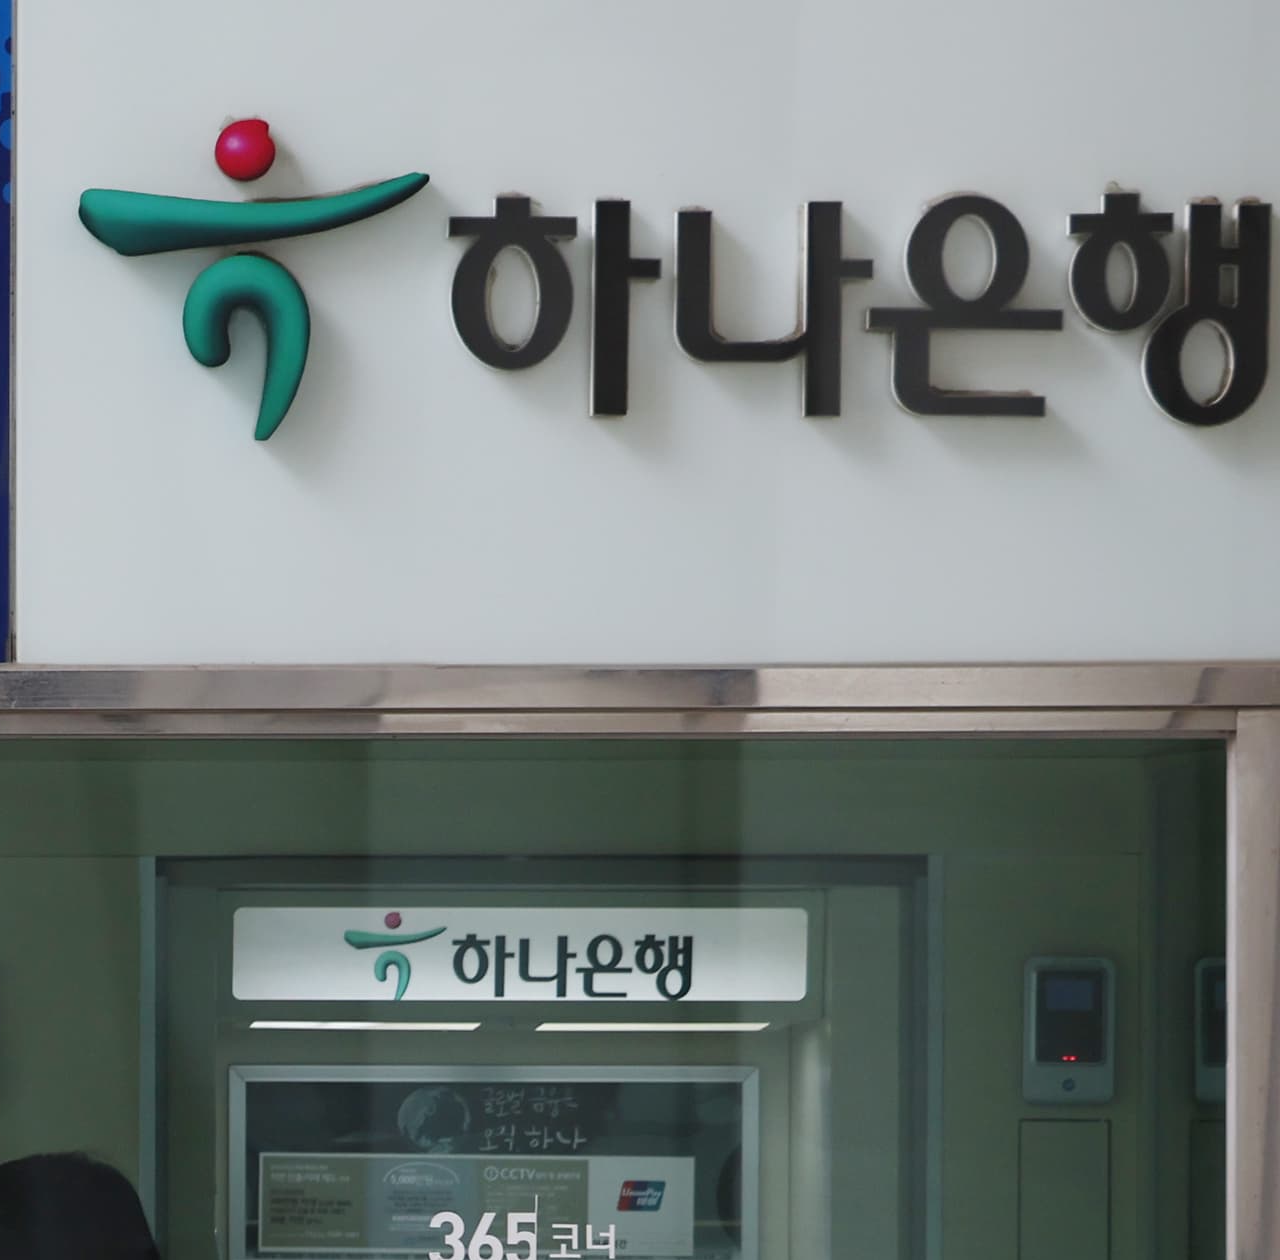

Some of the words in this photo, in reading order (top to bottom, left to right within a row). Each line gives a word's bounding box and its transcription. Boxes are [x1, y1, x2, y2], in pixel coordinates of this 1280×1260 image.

[447, 190, 1272, 428] 하나은행
[452, 934, 694, 1001] 하나은행
[478, 1123, 517, 1152] 오직
[523, 1124, 588, 1151] 하나
[500, 1168, 535, 1181] CCTV
[550, 1223, 616, 1259] 코너
